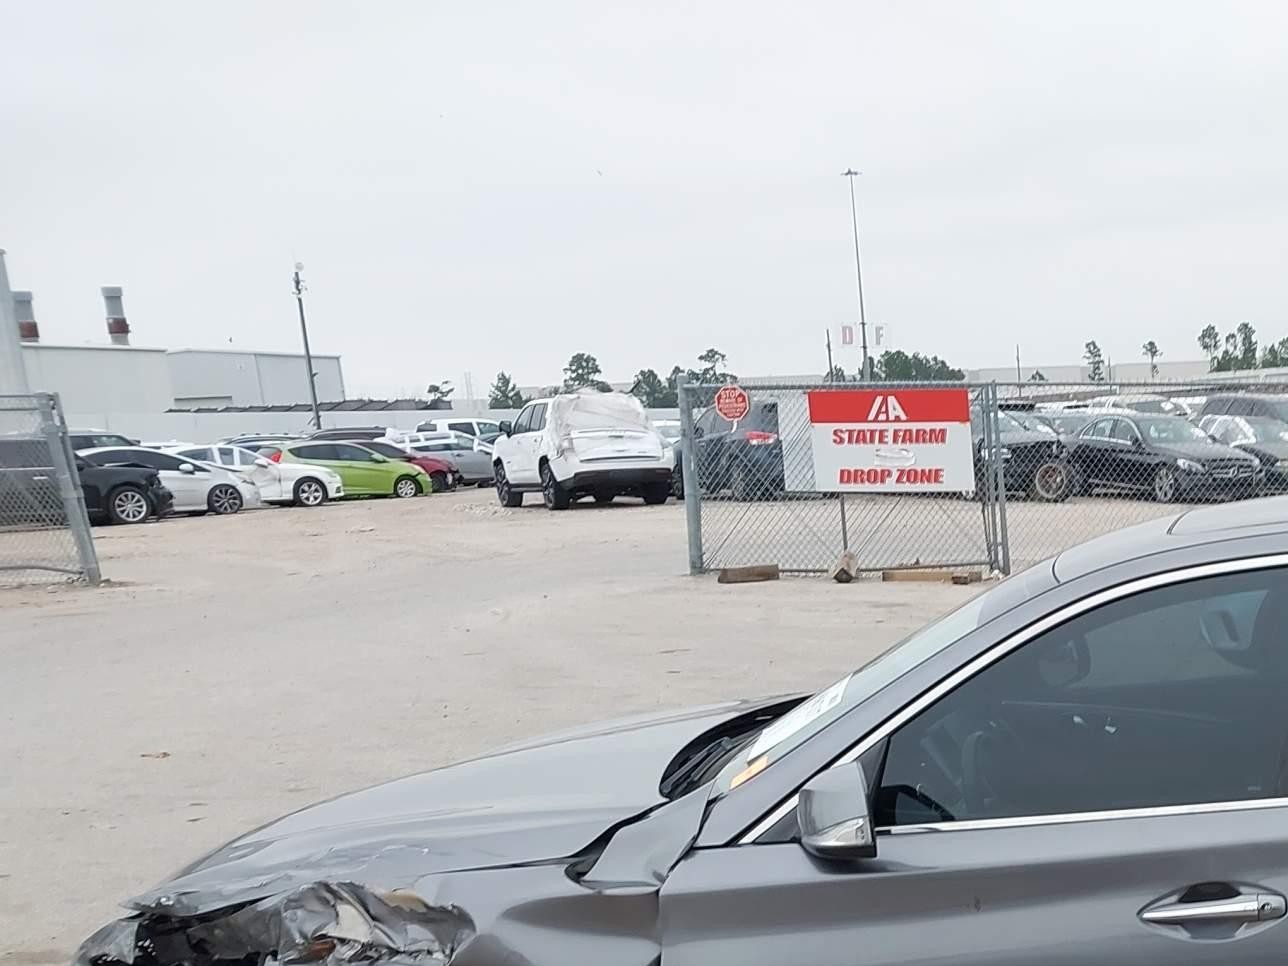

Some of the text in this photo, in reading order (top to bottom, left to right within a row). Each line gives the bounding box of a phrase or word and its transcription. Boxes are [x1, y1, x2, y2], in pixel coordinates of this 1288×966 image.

[841, 326, 854, 345] D
[875, 326, 884, 345] F
[720, 390, 740, 399] STOP
[832, 427, 948, 444] STATE FARM
[838, 468, 945, 485] DROP ZONE
